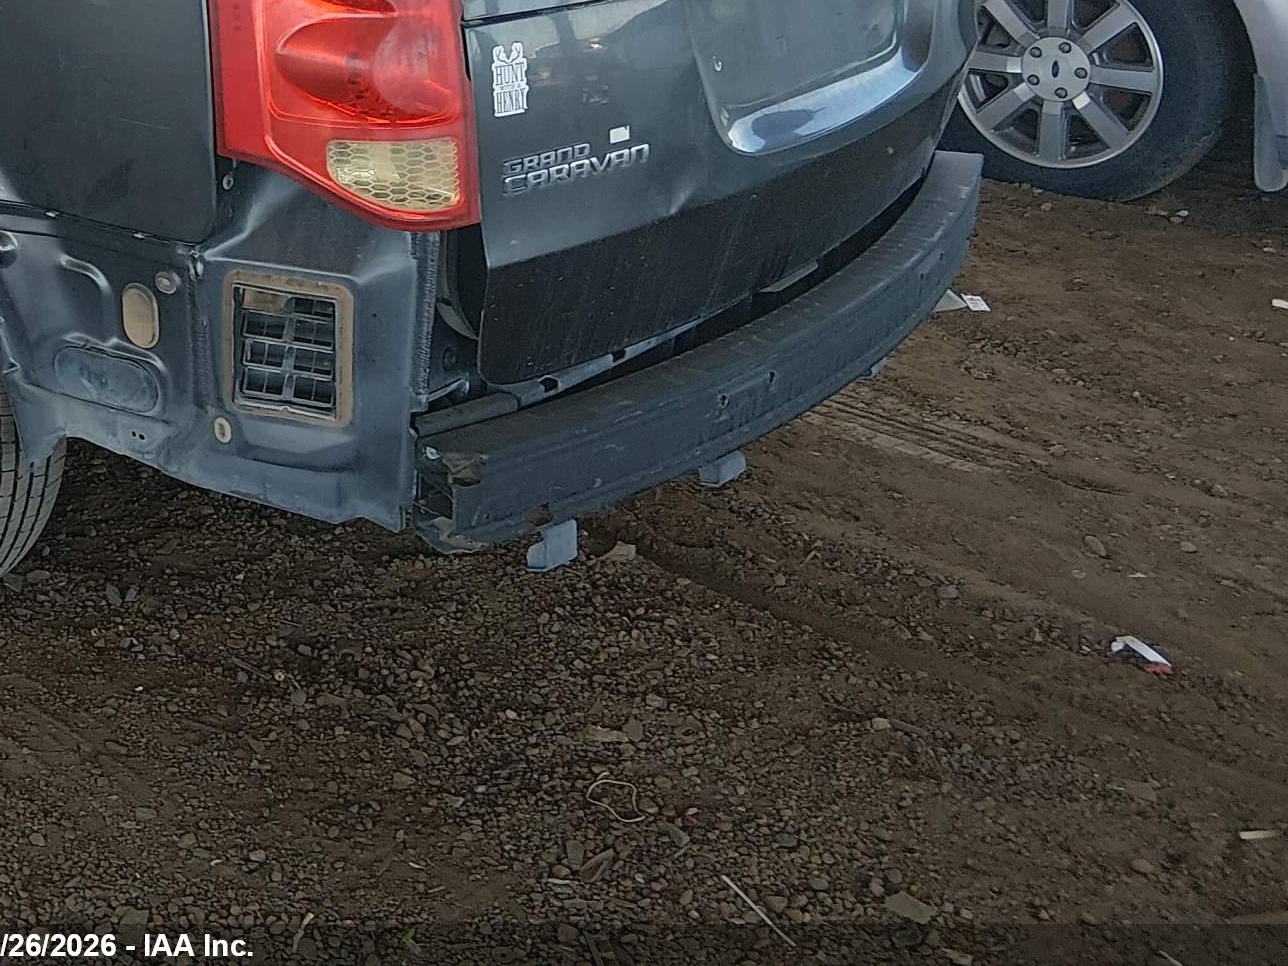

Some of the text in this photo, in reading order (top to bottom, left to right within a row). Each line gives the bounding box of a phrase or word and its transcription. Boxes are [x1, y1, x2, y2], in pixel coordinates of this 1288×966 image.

[496, 62, 525, 86] HUNT
[496, 87, 527, 114] HENRY
[503, 143, 591, 176] GRAND
[503, 143, 650, 196] CARAVAN
